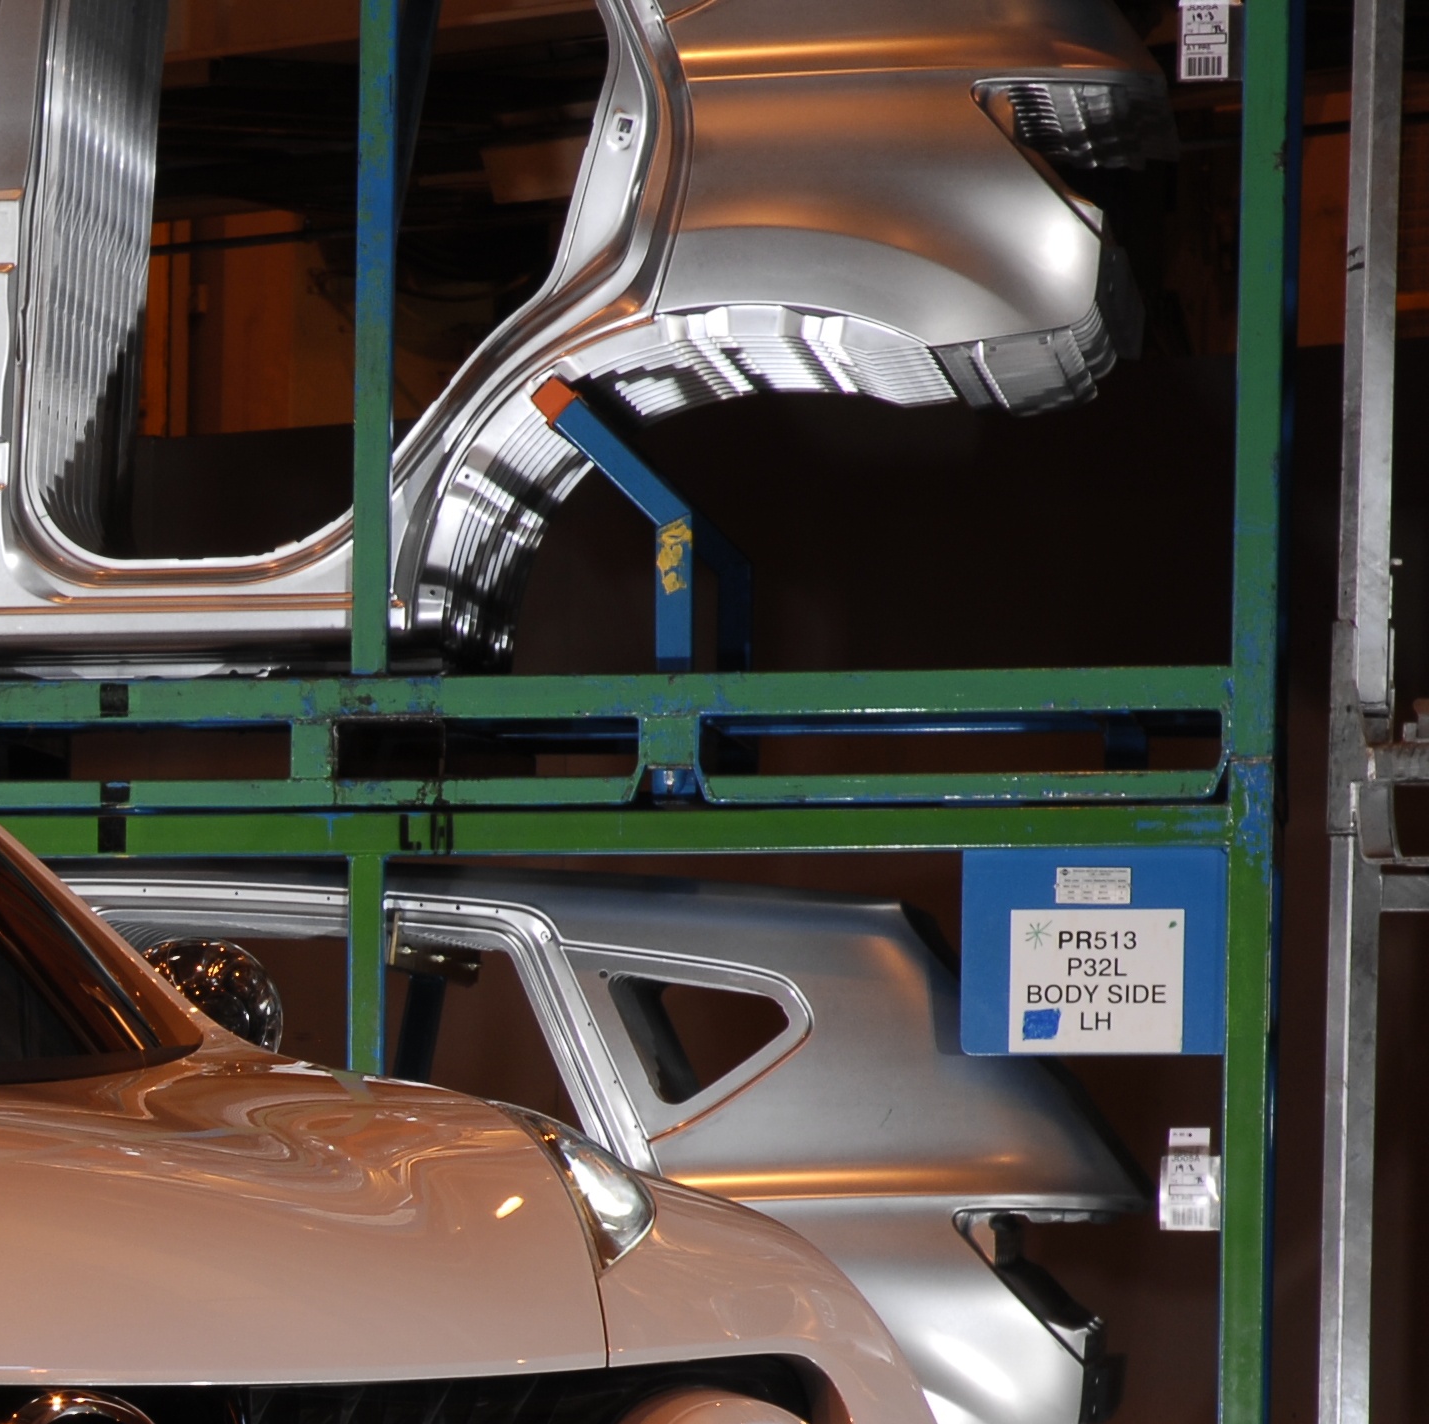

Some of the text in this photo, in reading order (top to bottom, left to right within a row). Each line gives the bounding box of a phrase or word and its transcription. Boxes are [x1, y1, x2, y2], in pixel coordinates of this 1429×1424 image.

[1058, 930, 1137, 950] PR513
[1067, 957, 1128, 977] P32L
[1027, 984, 1167, 1004] BODY SIDE
[1080, 1012, 1111, 1031] LH
